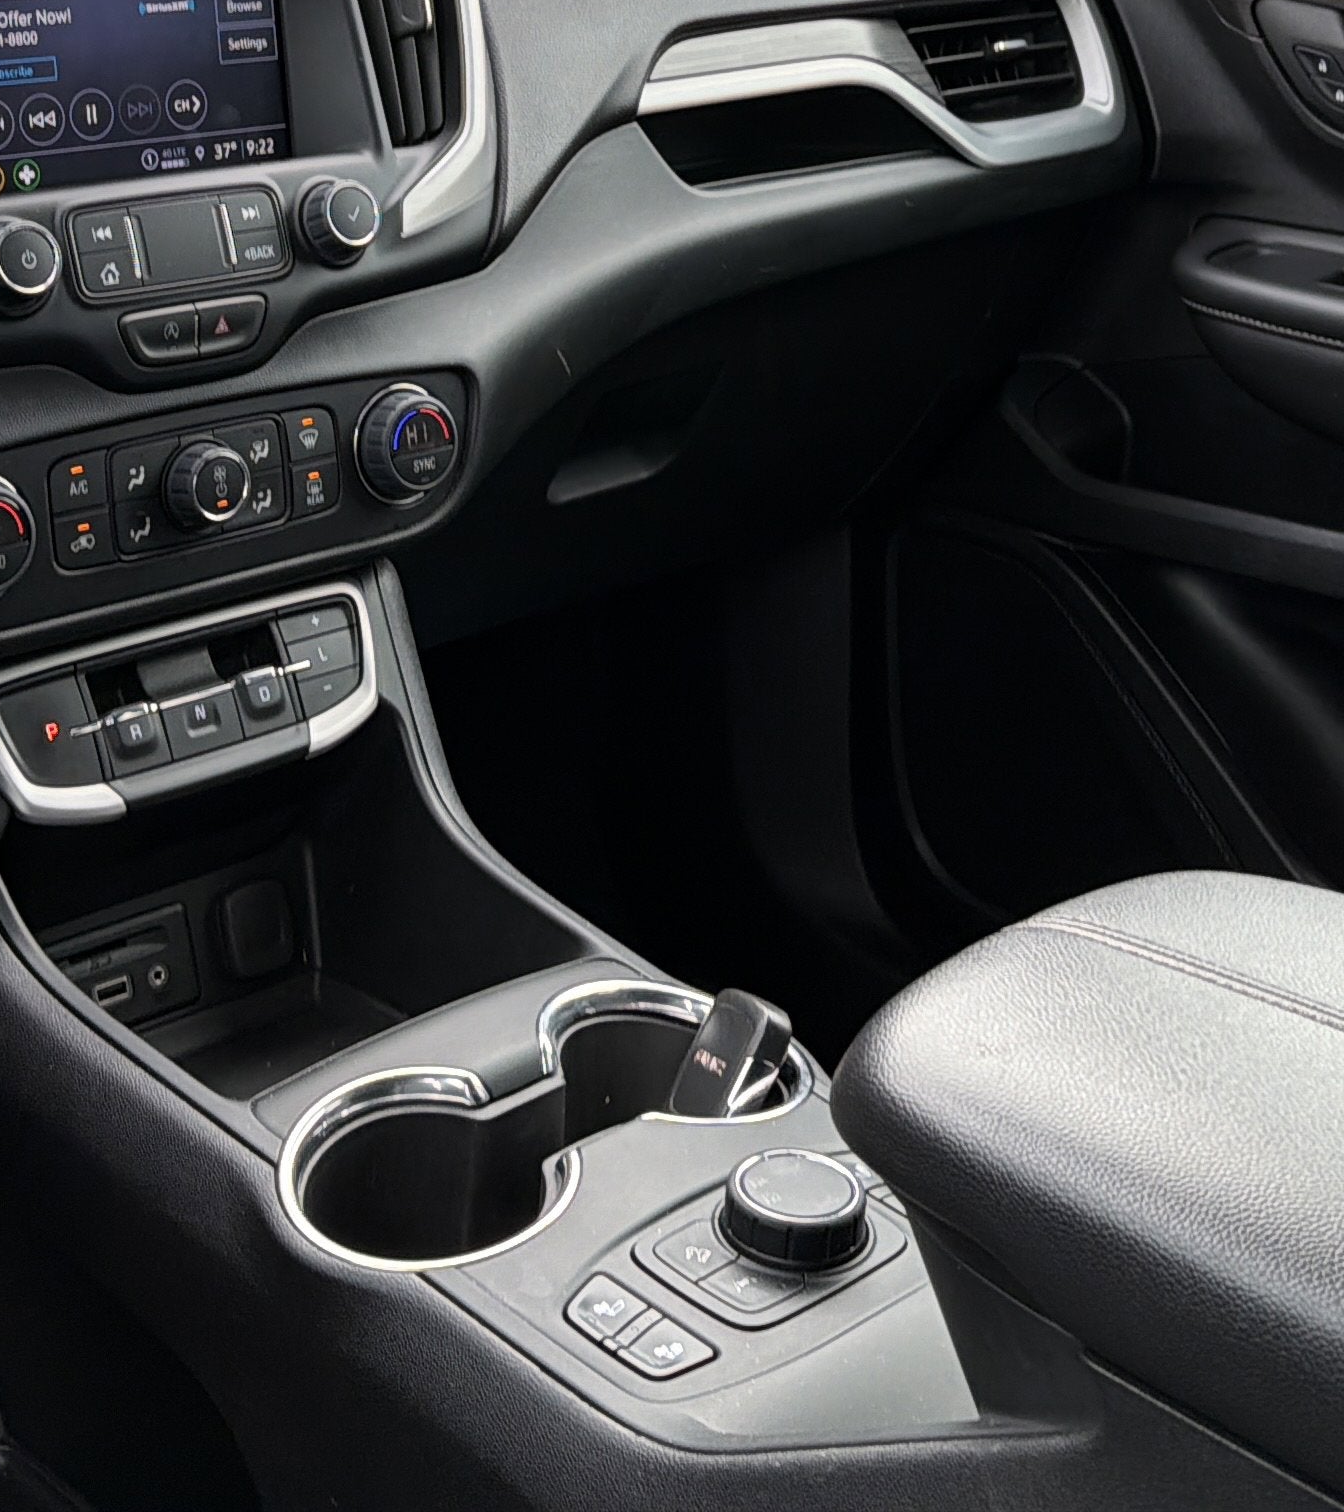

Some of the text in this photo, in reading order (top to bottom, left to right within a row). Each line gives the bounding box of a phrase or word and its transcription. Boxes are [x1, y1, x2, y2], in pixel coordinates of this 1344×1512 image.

[36, 7, 72, 26] Now!
[228, 36, 268, 52] Settings
[174, 99, 190, 114] CH
[246, 137, 275, 156] 9:22
[250, 244, 275, 261] BACK
[413, 455, 436, 473] SYNC
[69, 479, 89, 497] A/C
[306, 492, 324, 506] REAR
[317, 646, 329, 663] L
[194, 704, 207, 721] N
[44, 721, 59, 743] P
[129, 723, 143, 741] R
